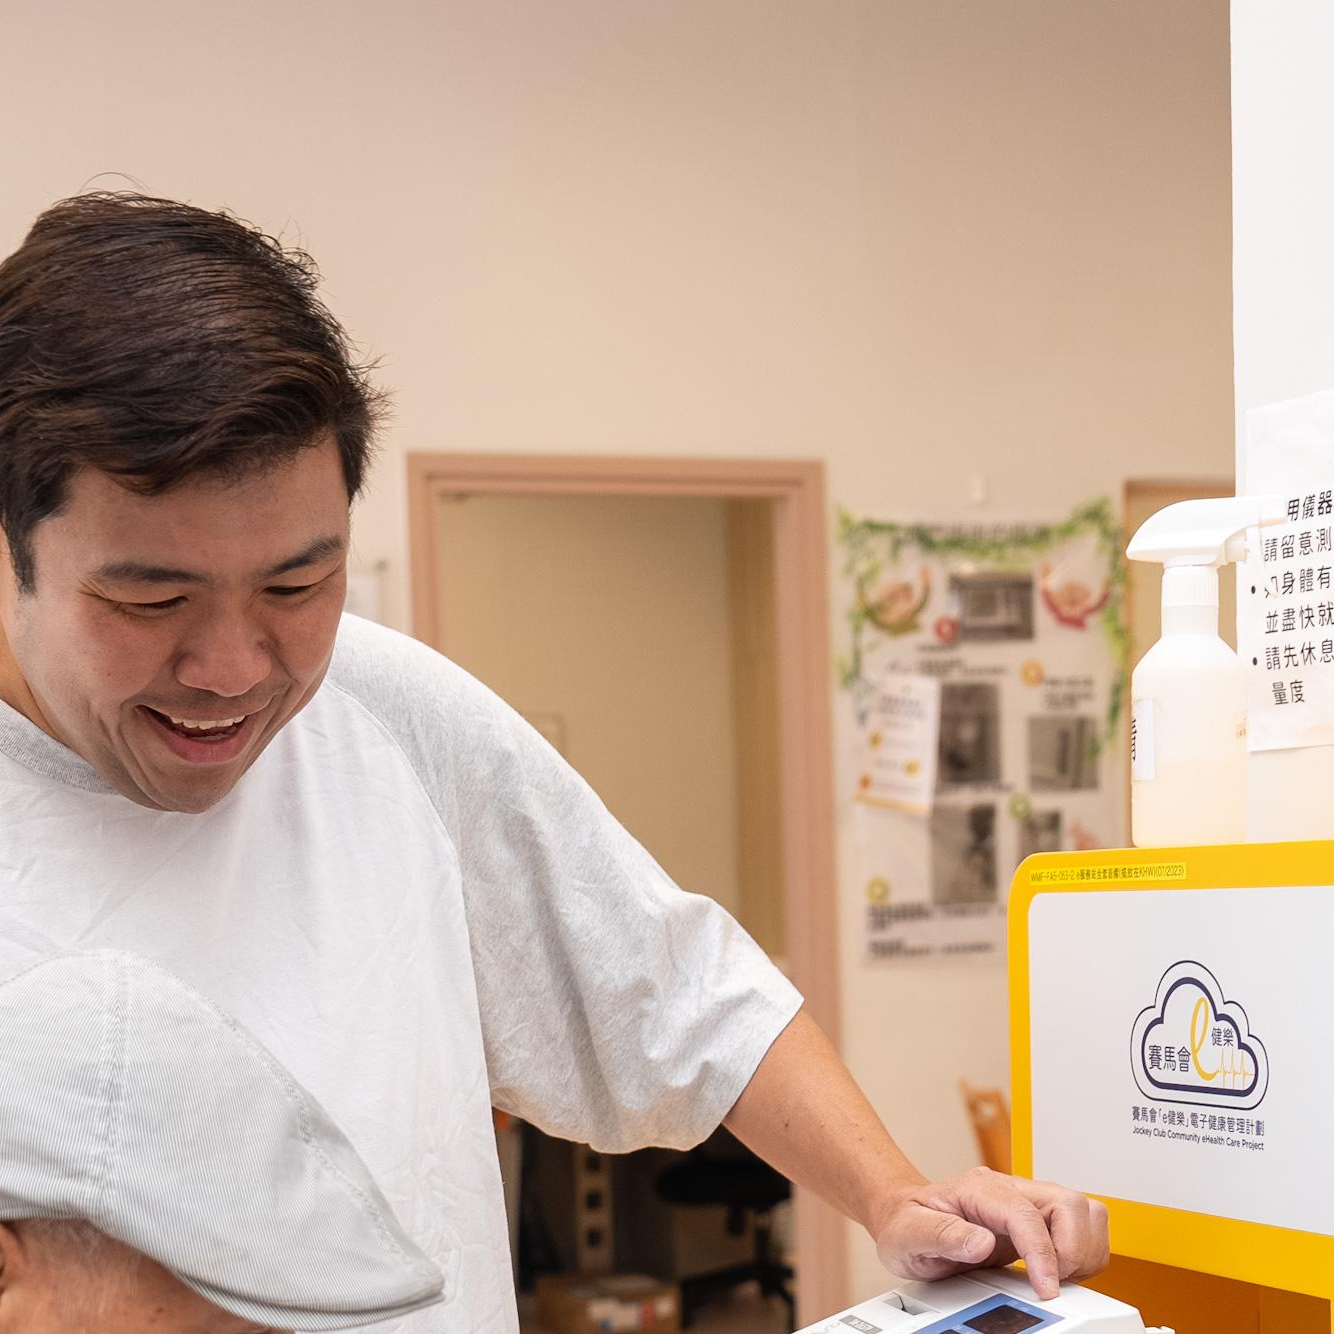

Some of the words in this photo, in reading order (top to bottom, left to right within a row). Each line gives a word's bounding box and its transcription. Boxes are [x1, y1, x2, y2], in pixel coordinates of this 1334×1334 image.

[1271, 680, 1307, 706] 量度
[1148, 1044, 1191, 1073] 賽馬會
[1211, 1028, 1234, 1047] 健樂
[1132, 1127, 1153, 1138] Jockey
[1153, 1128, 1166, 1138] Club
[1167, 1130, 1201, 1144] Community
[1202, 1133, 1225, 1145] eHealth
[1226, 1136, 1241, 1148] Care
[1241, 1138, 1265, 1151] Project
